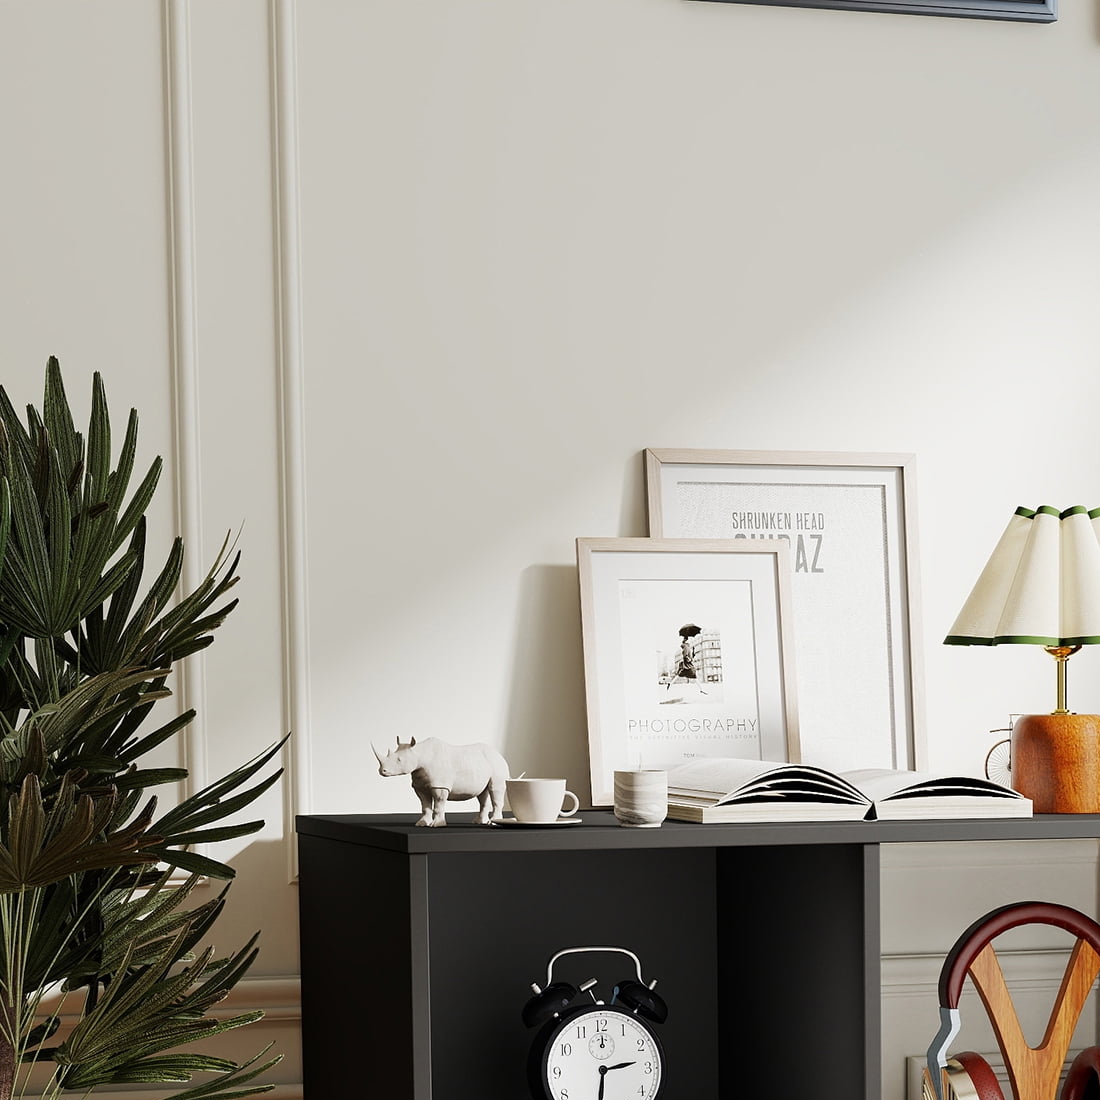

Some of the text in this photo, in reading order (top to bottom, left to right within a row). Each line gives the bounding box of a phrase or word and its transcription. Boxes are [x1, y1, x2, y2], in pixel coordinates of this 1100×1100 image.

[732, 512, 825, 531] SHRUNKEN HEAD
[628, 718, 758, 733] PHOTOGRAPHY
[595, 1019, 608, 1032] 12
[577, 1026, 586, 1039] 11
[561, 1043, 572, 1056] 10
[637, 1039, 645, 1052] 2
[553, 1066, 561, 1079] 9
[644, 1062, 653, 1075] 3
[560, 1088, 569, 1100] 8
[637, 1085, 646, 1097] 4
